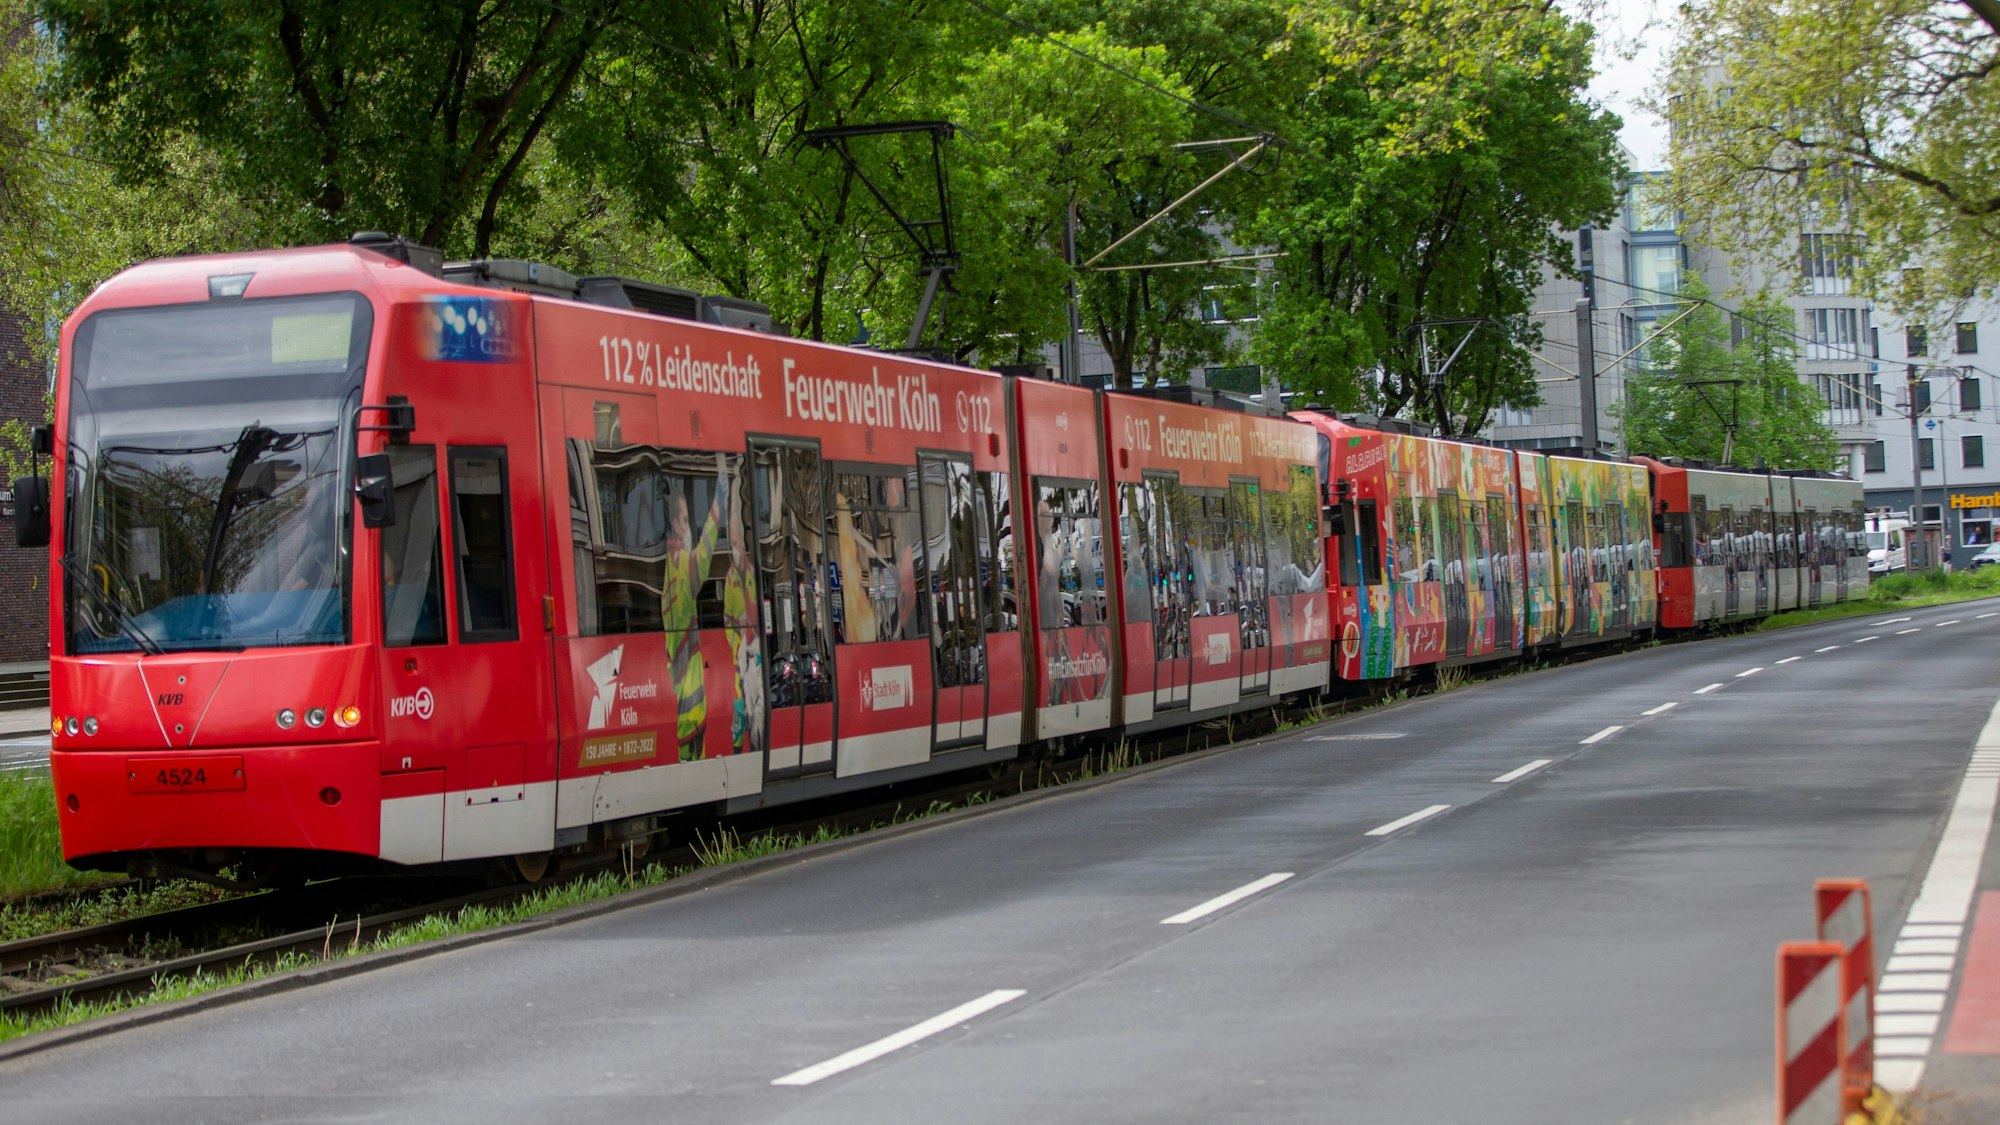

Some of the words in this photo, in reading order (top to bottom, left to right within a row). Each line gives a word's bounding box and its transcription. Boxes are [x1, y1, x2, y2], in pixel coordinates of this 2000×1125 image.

[600, 335, 635, 384] 112
[655, 343, 763, 400] Leidenschaft
[783, 358, 895, 429] Feuerwehr
[897, 373, 941, 433] Köln
[969, 395, 992, 435] 112
[1134, 417, 1151, 451] 112
[1158, 415, 1217, 462] Feuerwehr
[1217, 421, 1242, 464] Köln
[157, 693, 184, 706] KVB
[619, 679, 657, 700] Feuerwehr
[391, 696, 415, 717] KVB
[621, 706, 638, 727] Köln
[586, 745, 596, 760] 150
[598, 742, 617, 757] JAHRE
[157, 767, 207, 786] 4524
